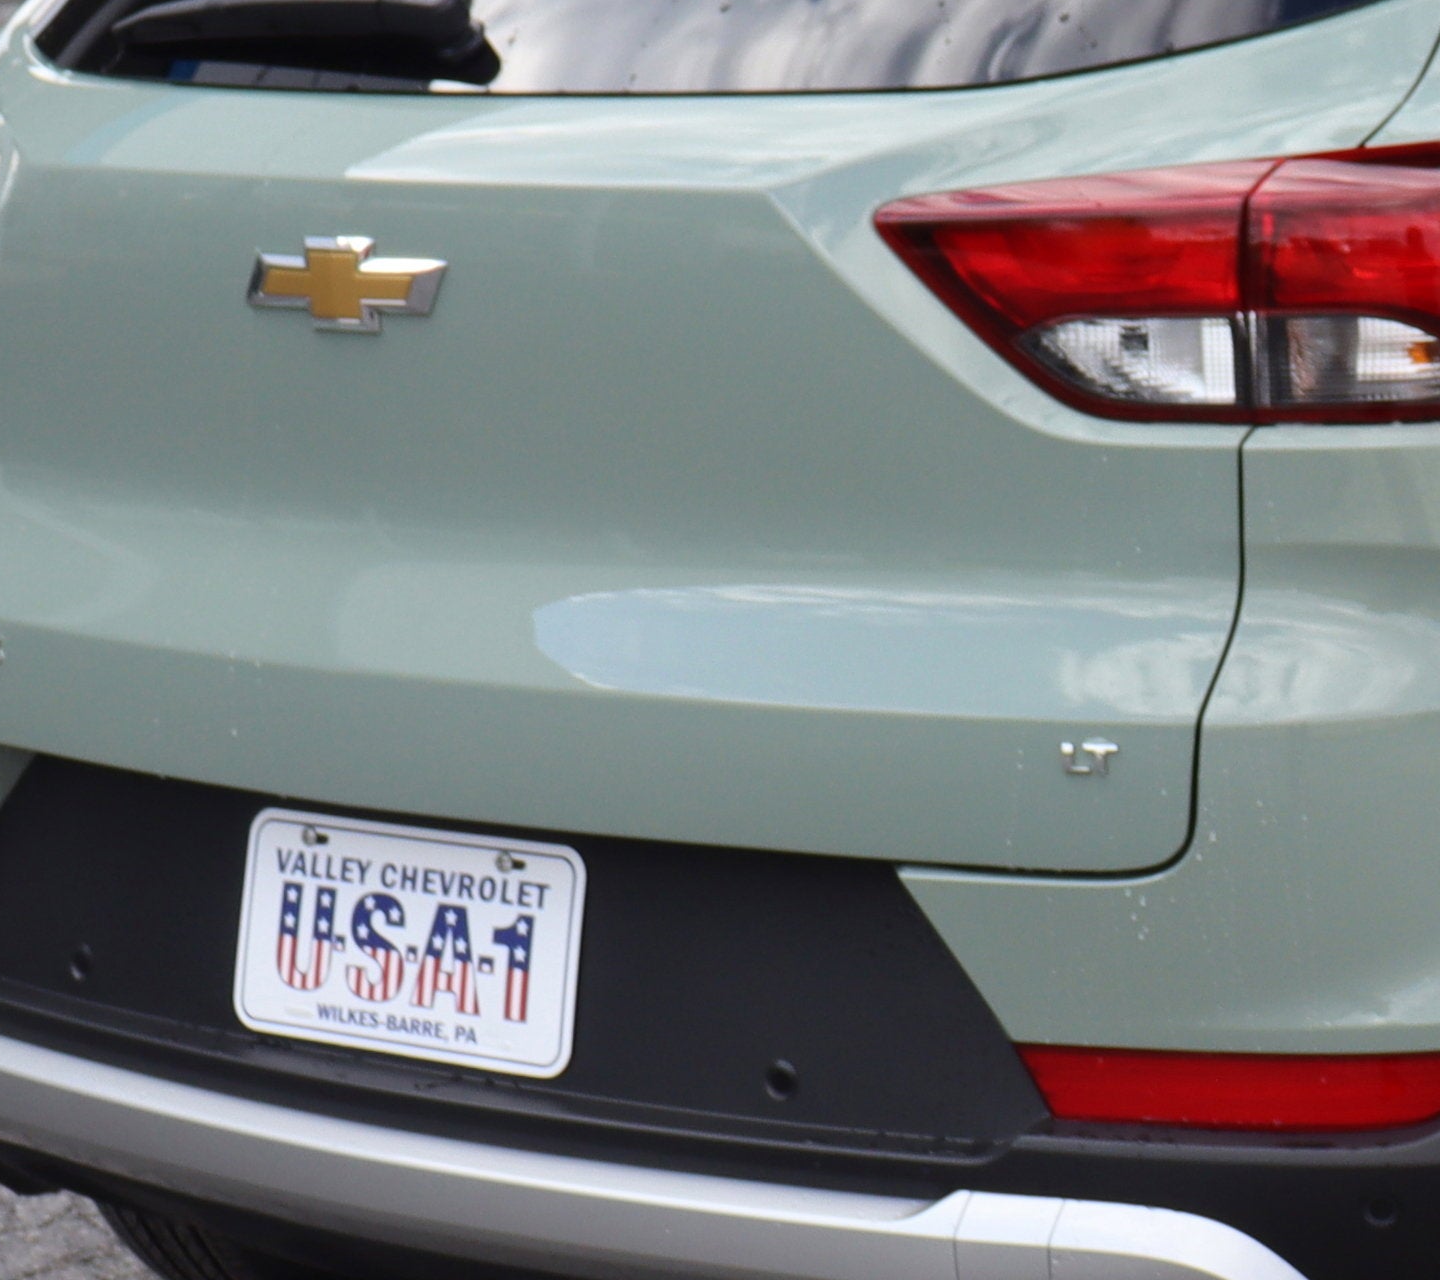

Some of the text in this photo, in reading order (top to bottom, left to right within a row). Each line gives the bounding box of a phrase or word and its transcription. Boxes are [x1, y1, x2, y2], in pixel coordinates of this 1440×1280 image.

[1060, 740, 1119, 777] LT
[276, 846, 550, 909] VALLEY CHEVROLET
[316, 1003, 479, 1045] WILKES-BARRE, PA
